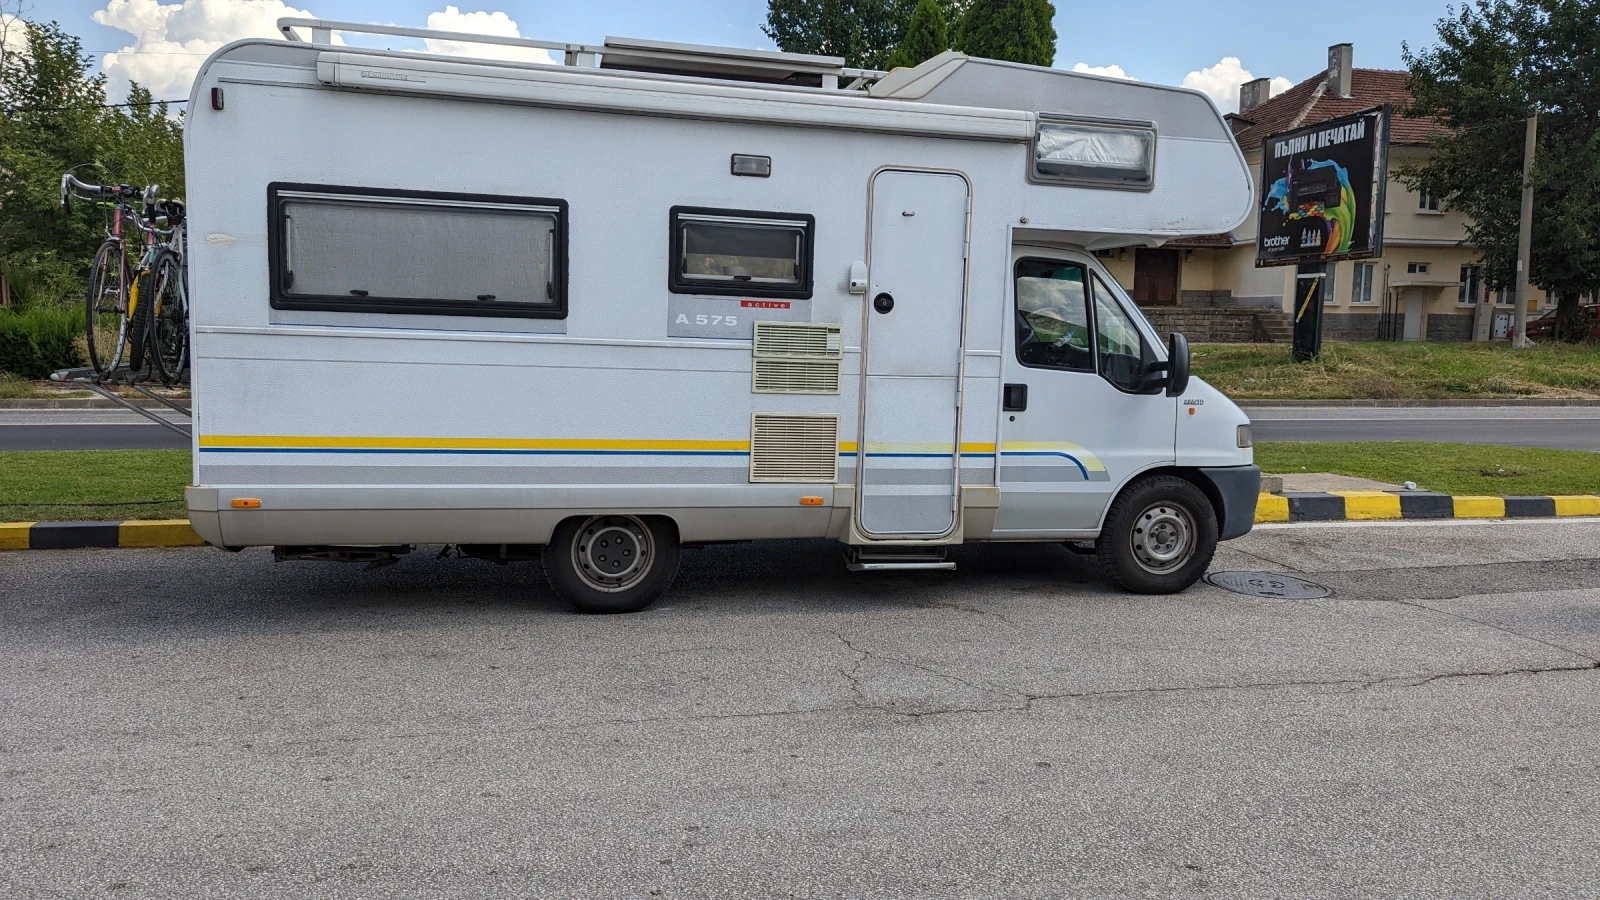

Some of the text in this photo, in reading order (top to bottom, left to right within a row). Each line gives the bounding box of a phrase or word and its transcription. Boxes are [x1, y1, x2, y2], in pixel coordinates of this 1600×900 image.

[1275, 118, 1365, 158] ПЪЛНИ И ПЕЧАТАЙ
[1264, 235, 1290, 247] brother
[675, 313, 738, 326] A 575
